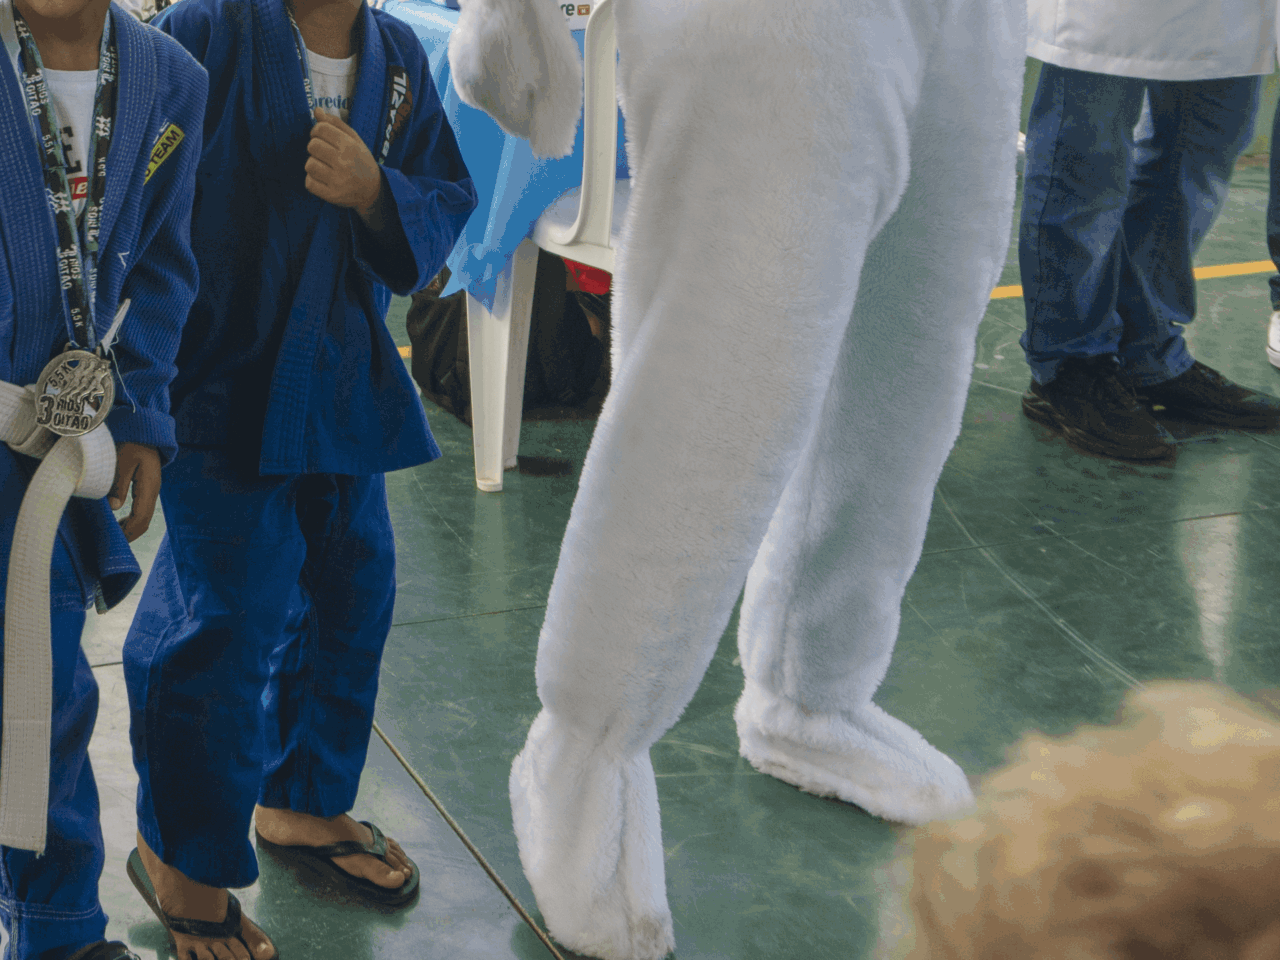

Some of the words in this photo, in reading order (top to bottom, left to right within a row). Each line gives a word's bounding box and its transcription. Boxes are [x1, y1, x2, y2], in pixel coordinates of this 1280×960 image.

[36, 81, 49, 105] RIOS
[150, 129, 181, 165] TEAM
[69, 256, 81, 280] RIOS
[37, 395, 55, 426] 3
